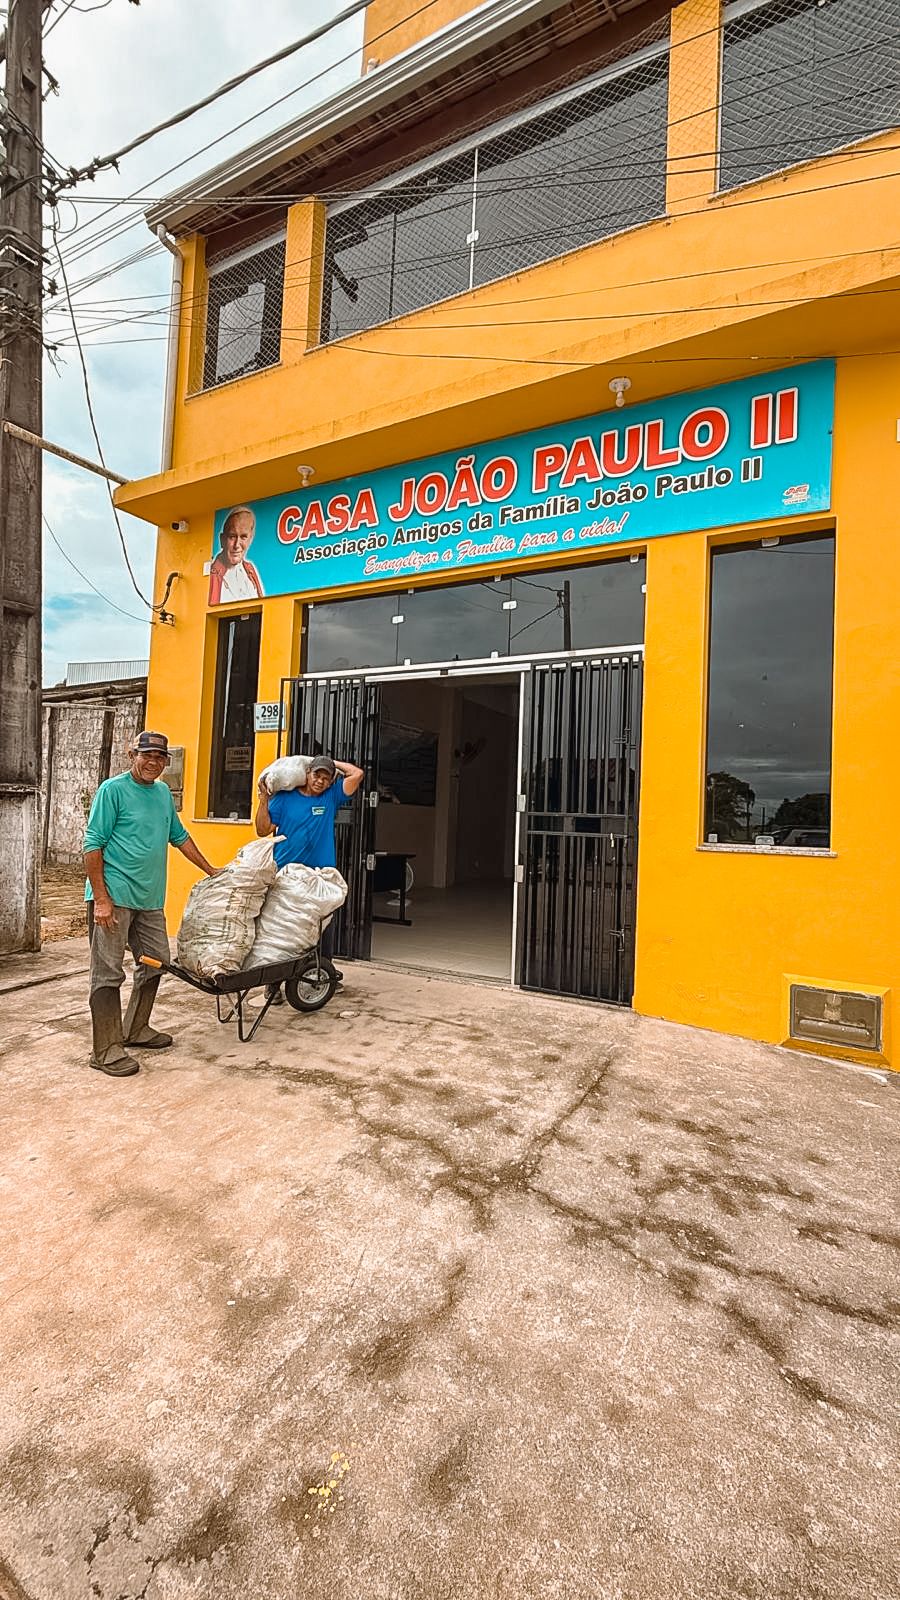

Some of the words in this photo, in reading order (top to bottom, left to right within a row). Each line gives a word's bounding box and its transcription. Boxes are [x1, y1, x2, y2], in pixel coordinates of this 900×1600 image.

[277, 487, 378, 544] CASA
[388, 454, 518, 521] JOÃO
[531, 406, 730, 494] PAULO
[750, 387, 798, 449] II
[294, 534, 388, 564] Associação
[392, 520, 462, 548] Amigos
[467, 511, 493, 531] da
[500, 496, 580, 525] Família
[587, 482, 648, 510] João
[656, 463, 732, 497] Paulo
[741, 456, 763, 483] II
[363, 550, 438, 576] Evangelizar
[442, 549, 453, 562] a
[456, 535, 515, 560] Família
[518, 532, 558, 555] para
[562, 528, 575, 541] a
[580, 512, 629, 537] vida!
[261, 704, 279, 718] 298
